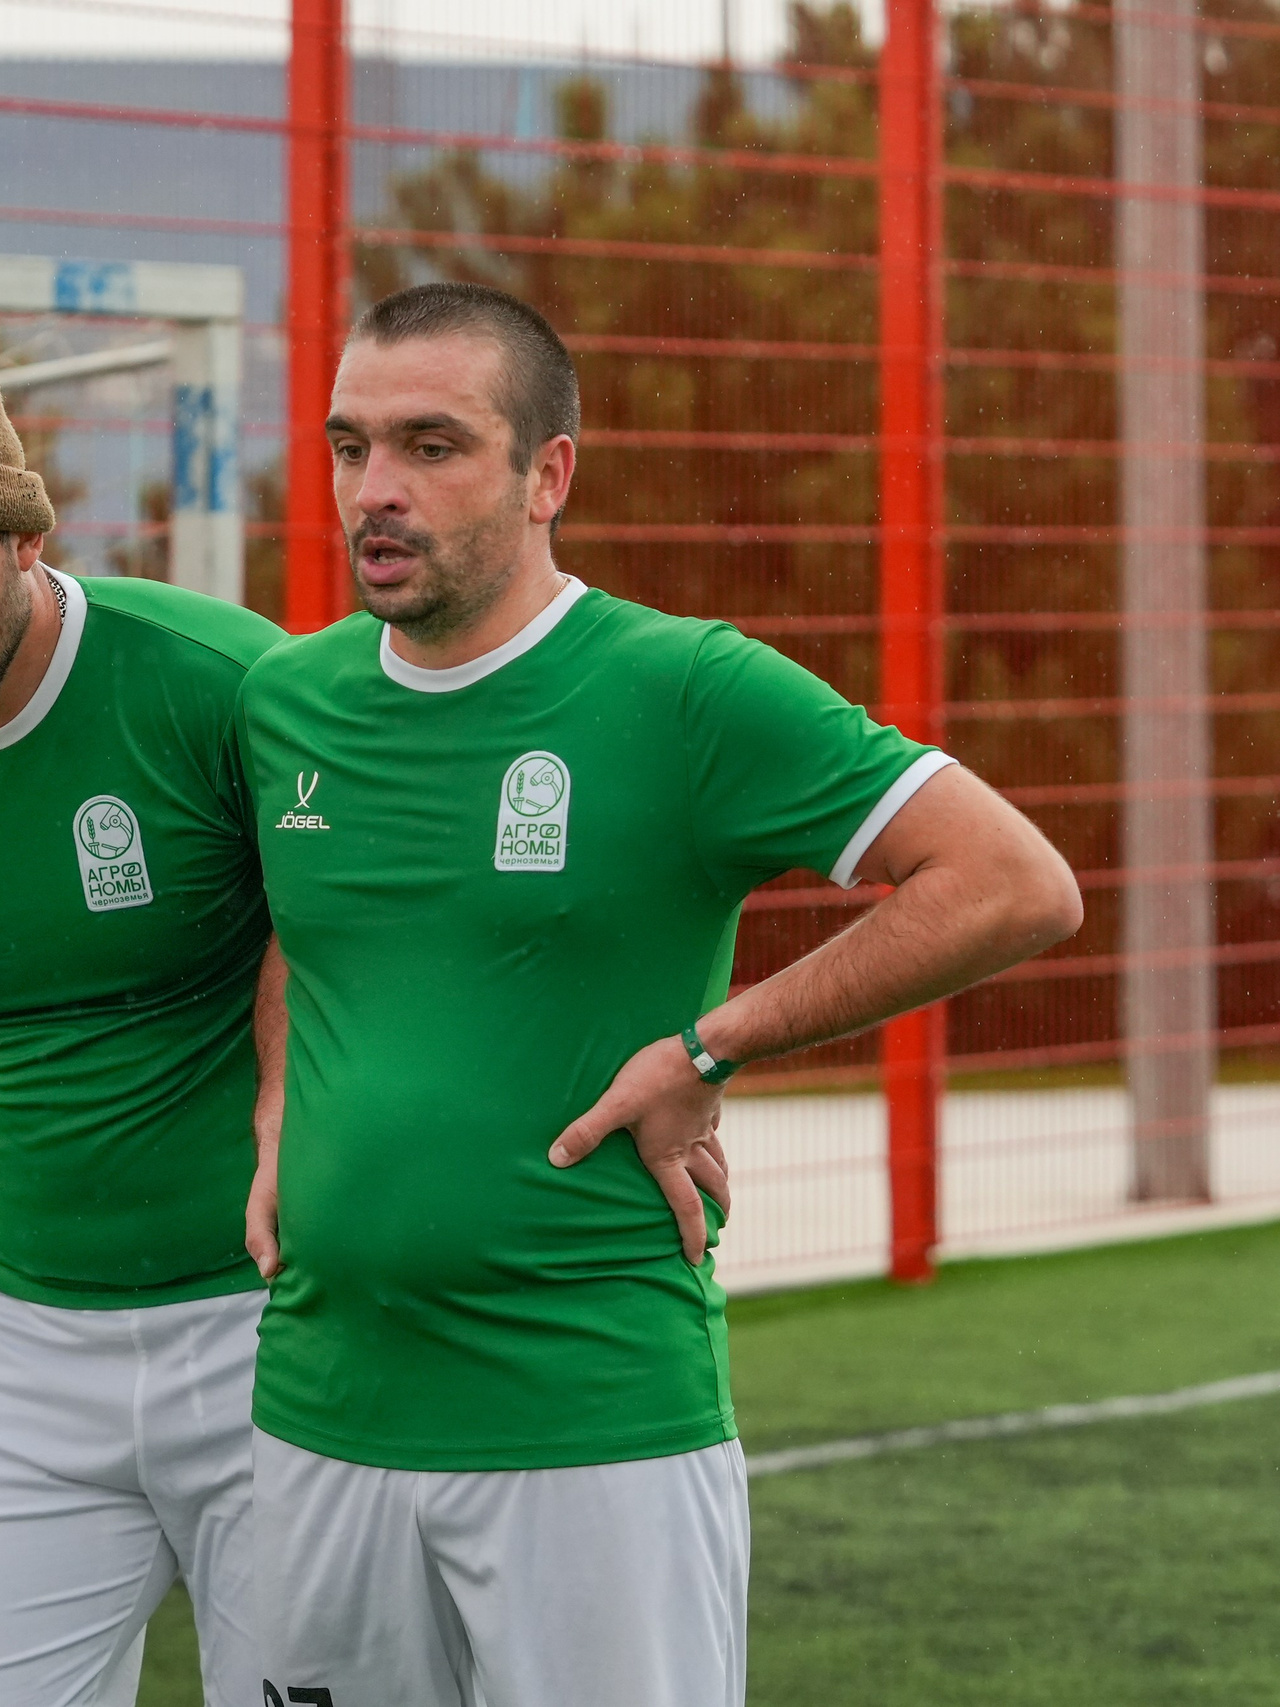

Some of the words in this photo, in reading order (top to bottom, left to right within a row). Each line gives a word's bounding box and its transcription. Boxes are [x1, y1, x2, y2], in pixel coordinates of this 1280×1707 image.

[275, 811, 331, 829] JÖGEL
[500, 840, 560, 856] НОМЫ
[499, 858, 559, 866] черноземья
[88, 877, 146, 898] НОМЫ
[91, 892, 149, 906] черноземья
